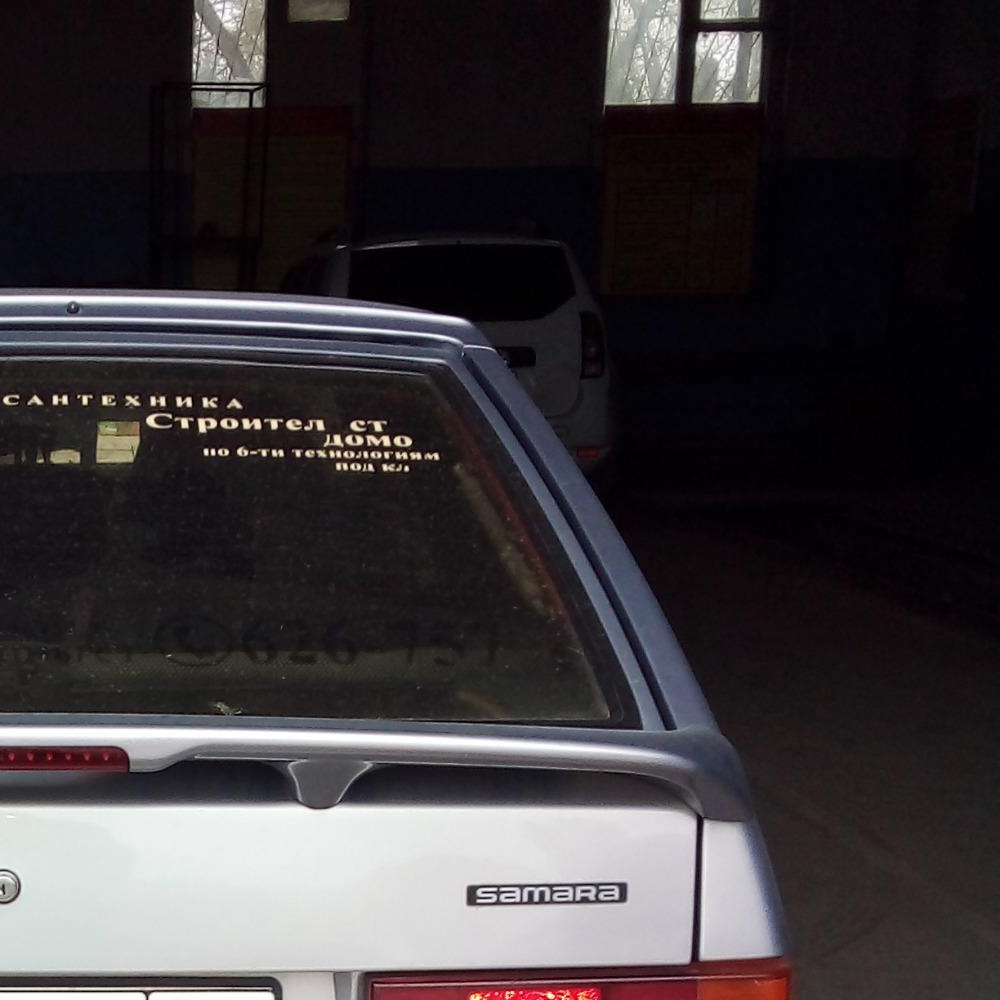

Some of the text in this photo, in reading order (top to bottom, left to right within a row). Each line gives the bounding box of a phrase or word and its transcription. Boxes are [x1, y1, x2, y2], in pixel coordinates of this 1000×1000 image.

[2, 394, 243, 410] САНТЕХНИКА
[202, 445, 441, 461] по 6-ти технологиям
[335, 462, 376, 473] под
